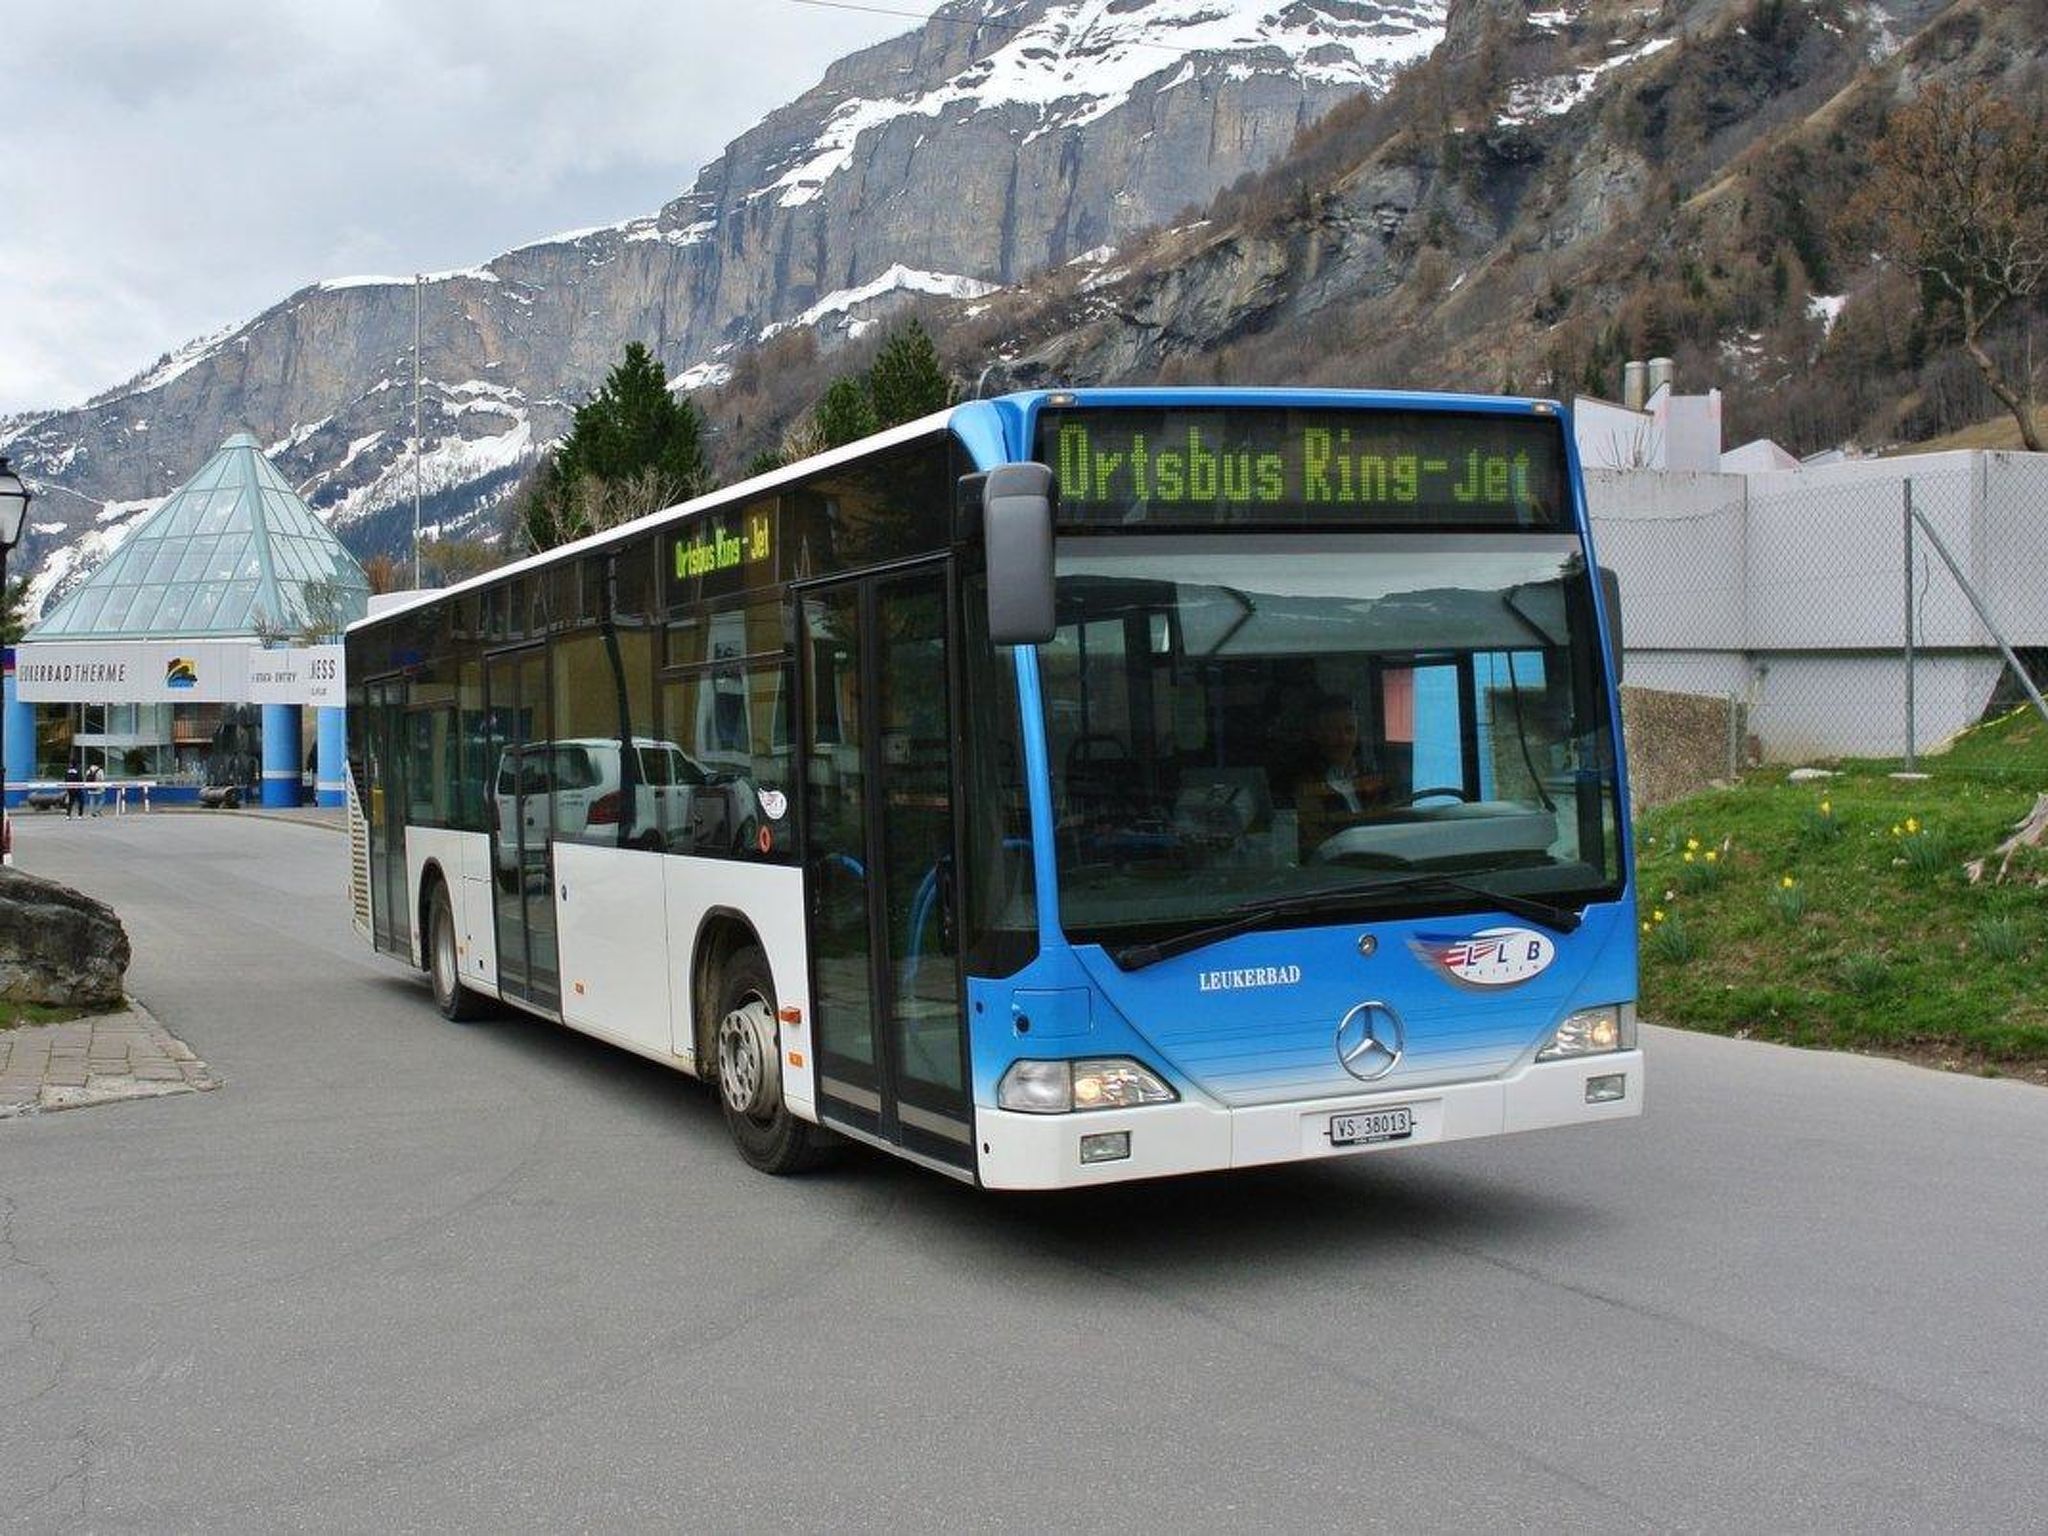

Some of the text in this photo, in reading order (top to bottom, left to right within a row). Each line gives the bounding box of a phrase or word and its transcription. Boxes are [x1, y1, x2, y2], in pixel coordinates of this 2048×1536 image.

[1060, 424, 1283, 500] Ortsbus
[75, 664, 126, 682] THERME
[1200, 965, 1301, 991] LEUKERBAD
[1337, 1113, 1406, 1137] VS 38013
